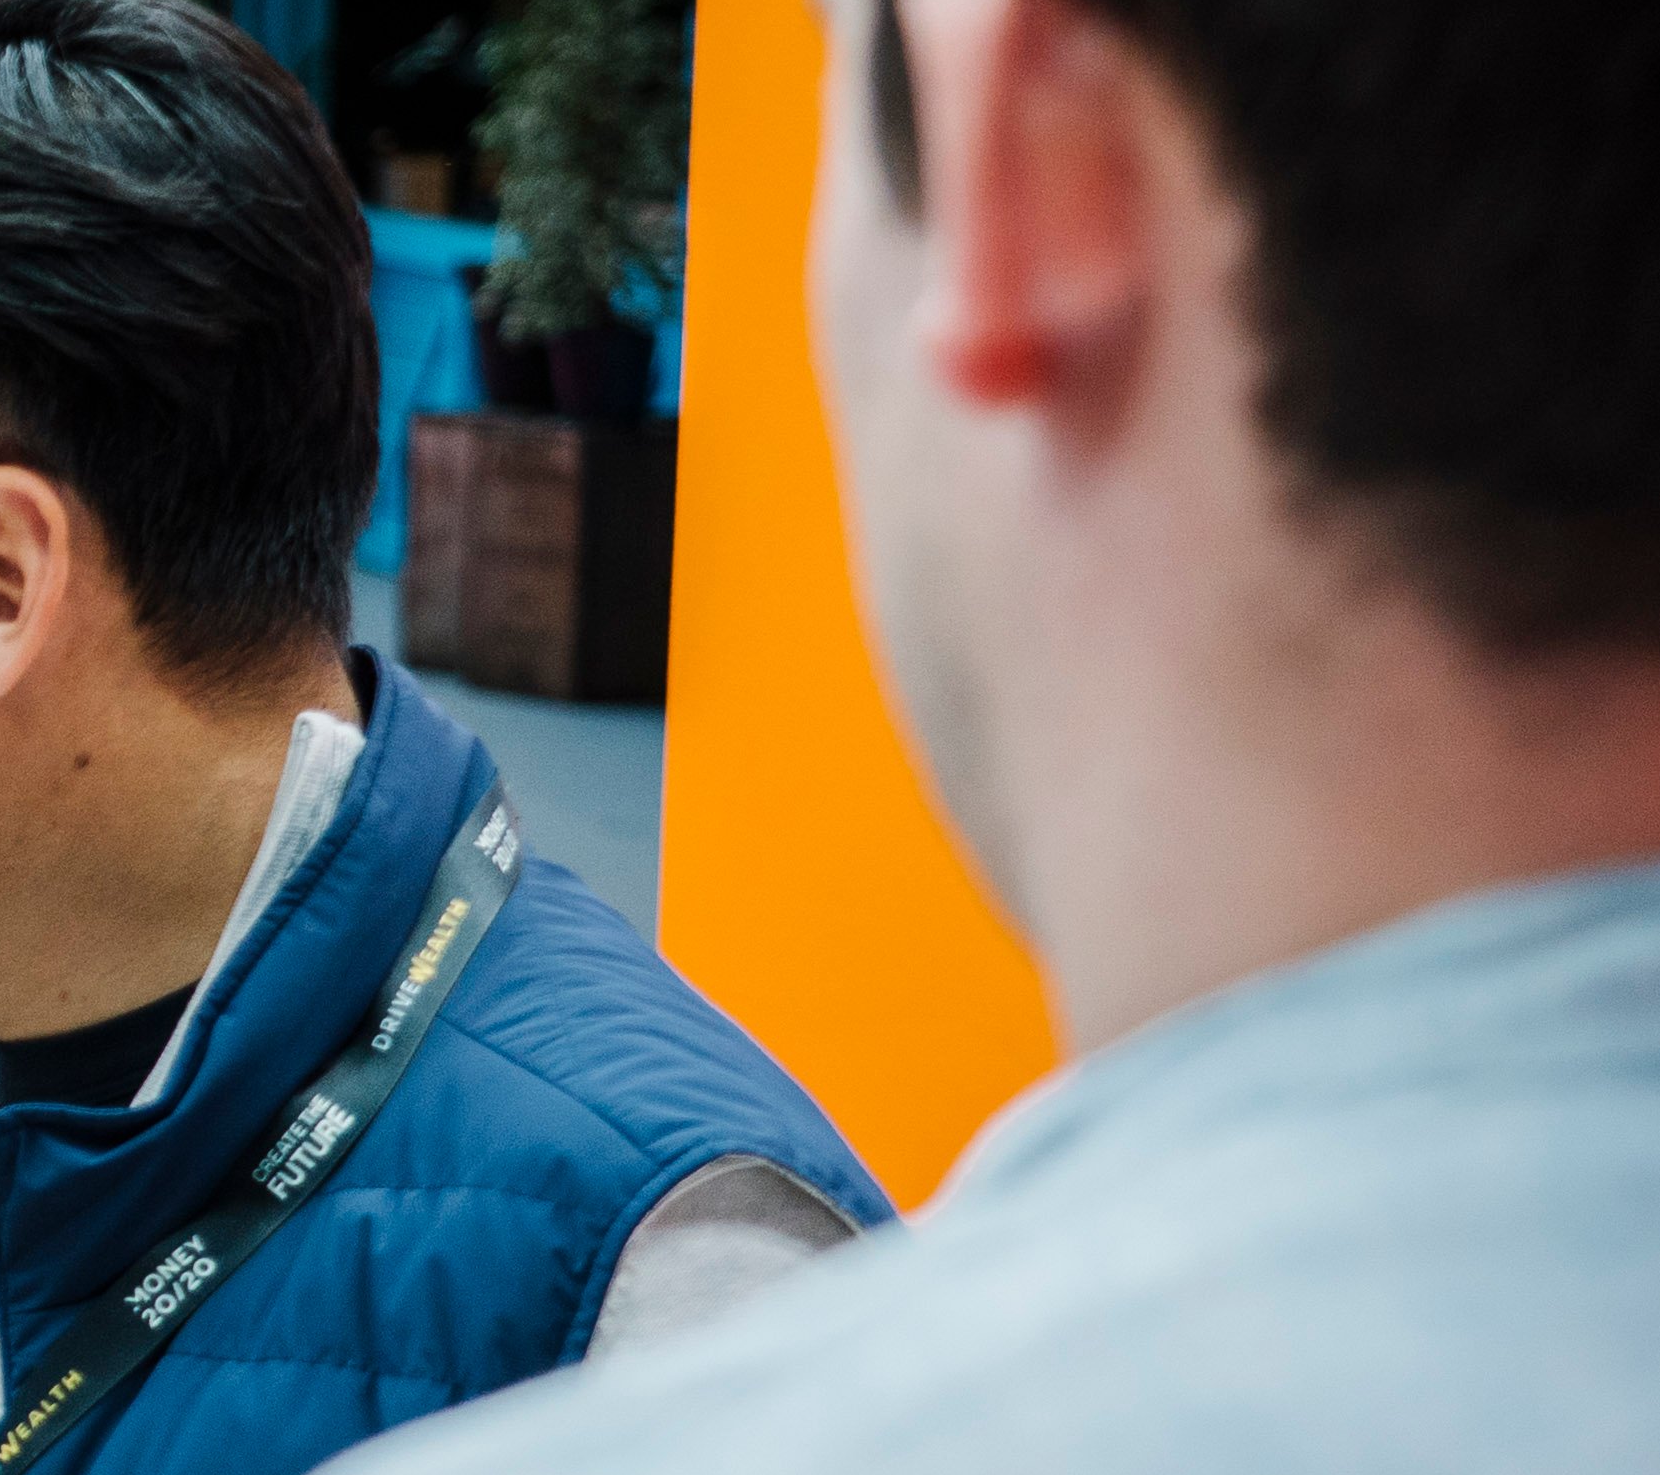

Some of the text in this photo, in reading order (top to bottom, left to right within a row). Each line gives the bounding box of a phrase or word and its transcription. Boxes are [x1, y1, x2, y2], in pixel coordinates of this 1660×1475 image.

[371, 897, 471, 1053] DRIVEWEALTH
[251, 1116, 309, 1183] CREATE
[267, 1103, 356, 1202] FUTURE
[124, 1233, 207, 1312] MONEY
[141, 1257, 217, 1329] 20/20
